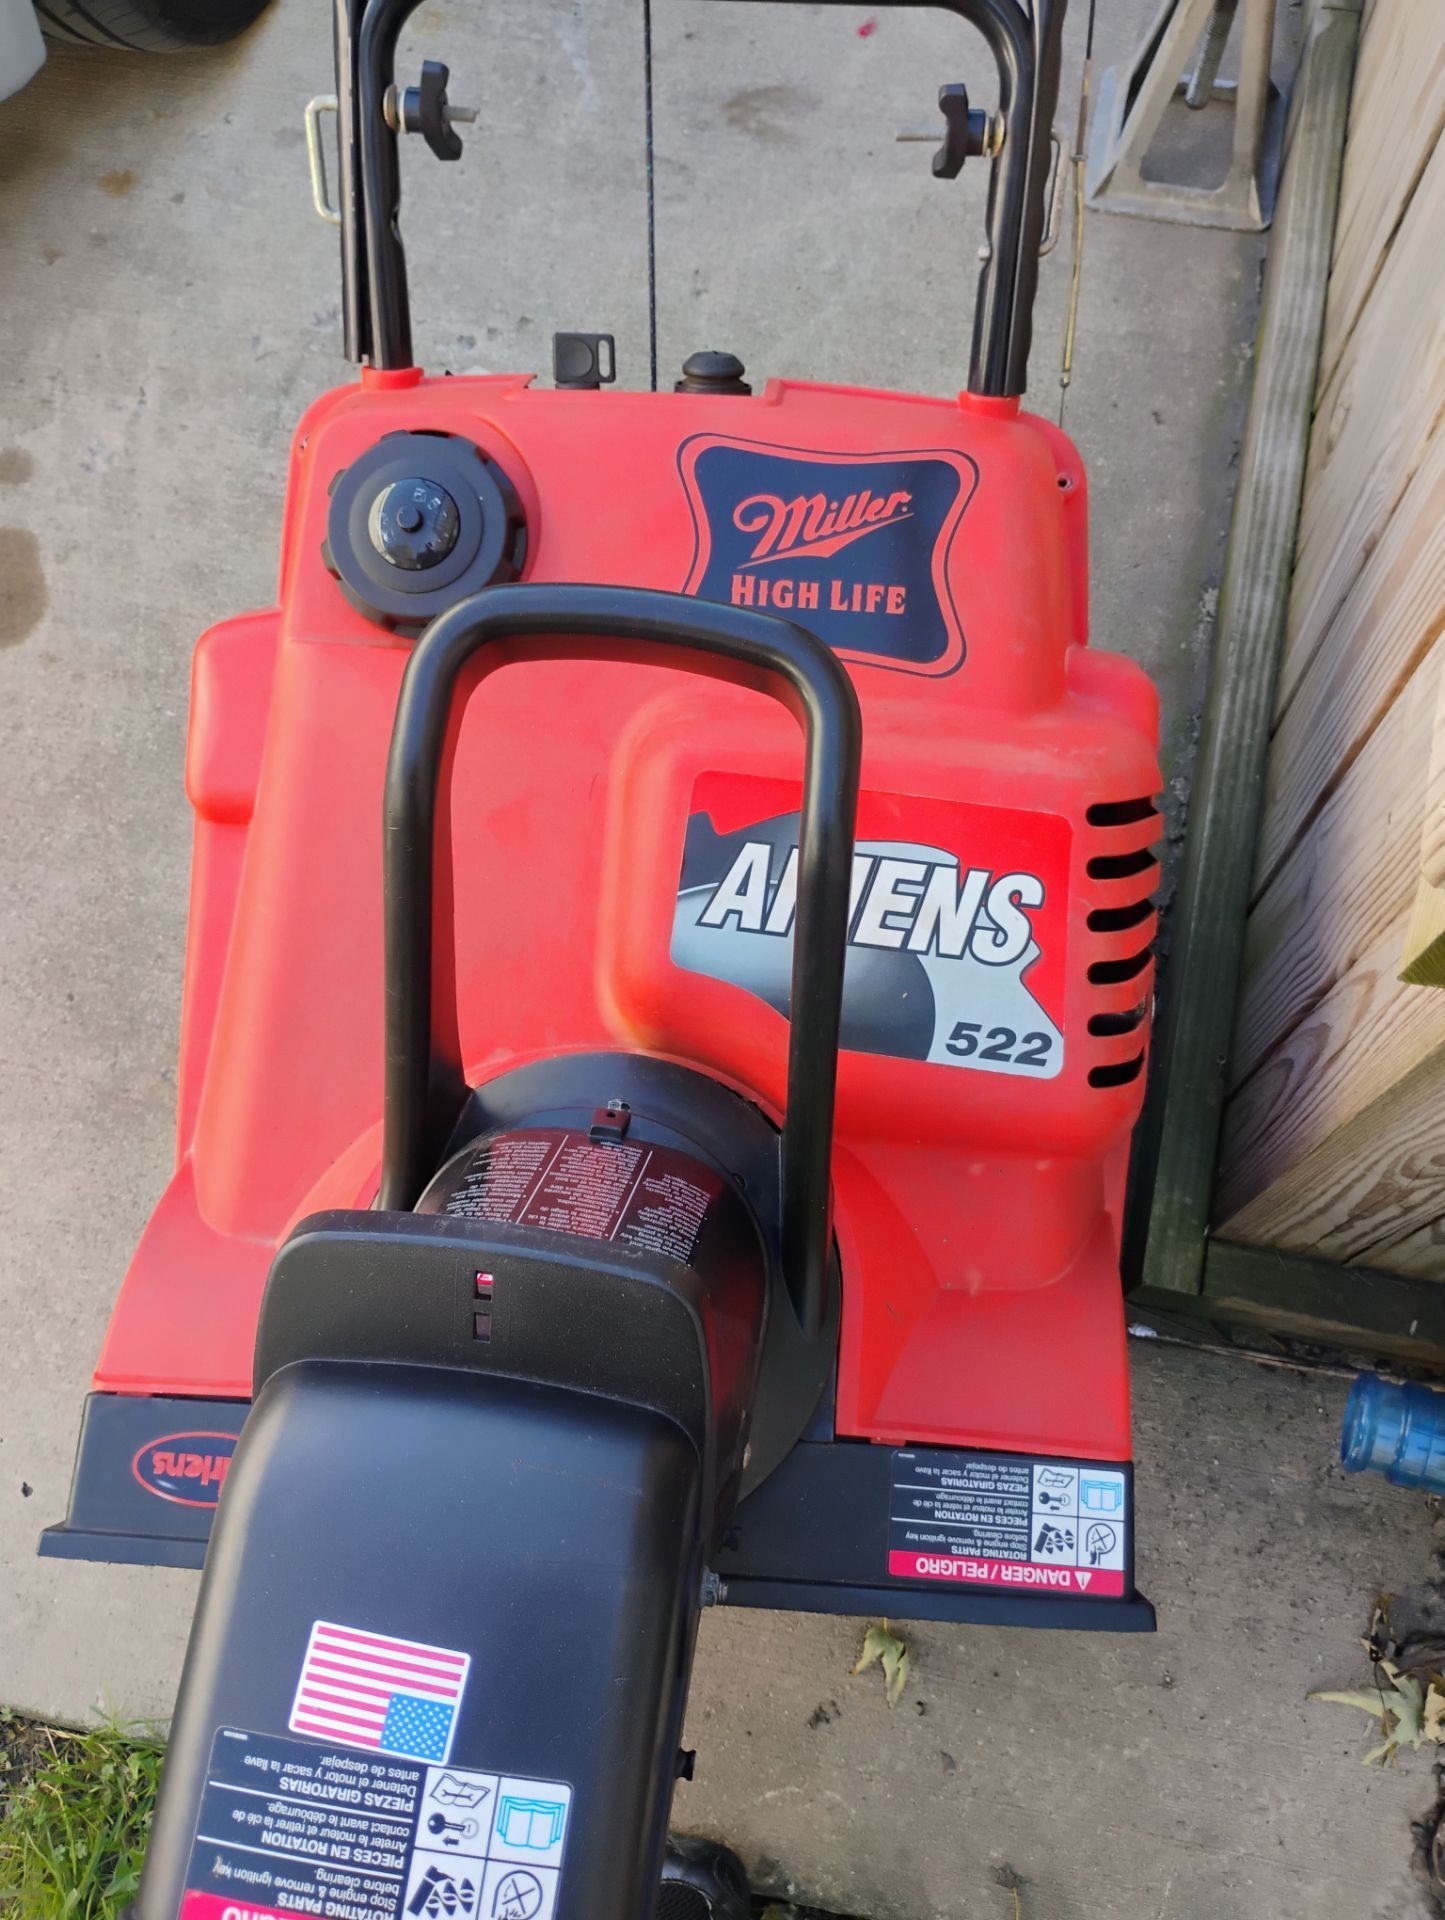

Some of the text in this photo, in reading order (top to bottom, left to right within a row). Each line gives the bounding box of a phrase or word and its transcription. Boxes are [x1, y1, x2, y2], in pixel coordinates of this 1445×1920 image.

[733, 490, 913, 560] Miller
[731, 574, 906, 615] HIGH LIFE
[945, 1021, 1053, 1067] 522
[915, 1466, 932, 1475] llave
[934, 1468, 940, 1476] la
[963, 1469, 968, 1477] y
[970, 1471, 990, 1479] motor
[998, 1465, 1008, 1473] de
[992, 1473, 998, 1481] el
[1000, 1474, 1028, 1482] Detener
[941, 1477, 1028, 1492] PIEZAS GIRATORIAS
[913, 1499, 922, 1507] de
[943, 1501, 961, 1510] retirer
[984, 1497, 1003, 1505] avant
[1005, 1499, 1028, 1507] contact
[972, 1504, 995, 1512] moteur
[997, 1506, 1003, 1515] le
[934, 1510, 1028, 1526] PIECES EN ROTATION
[905, 1531, 919, 1541] key
[921, 1533, 946, 1543] ignition
[947, 1536, 975, 1545] remove
[984, 1537, 1008, 1547] engine
[1004, 1532, 1027, 1541] before
[1010, 1540, 1027, 1551] Stop
[951, 1545, 1027, 1560] ROTATING PARTS
[916, 1558, 1070, 1586] DANGER / PELIGRO
[320, 1755, 419, 1783] antes de despejar.
[244, 1755, 417, 1796] Detener el motor y sacar la llave
[279, 1777, 414, 1811] PIEZAS GIRATORIAS
[232, 1810, 245, 1823] de
[246, 1813, 261, 1828] clé
[329, 1815, 338, 1827] le
[263, 1818, 273, 1830] la
[276, 1820, 304, 1836] retirer
[340, 1817, 372, 1831] avant
[307, 1826, 317, 1838] et
[320, 1828, 355, 1843] moteur
[372, 1823, 411, 1838] contact
[358, 1834, 368, 1847] le
[261, 1831, 405, 1866] PIECES EN ROTATION
[213, 1863, 397, 1911] Stop engine & remove ignition key
[314, 1868, 399, 1894] before clearing.
[277, 1892, 322, 1913] PARTS
[325, 1901, 395, 1920] ROTATING
